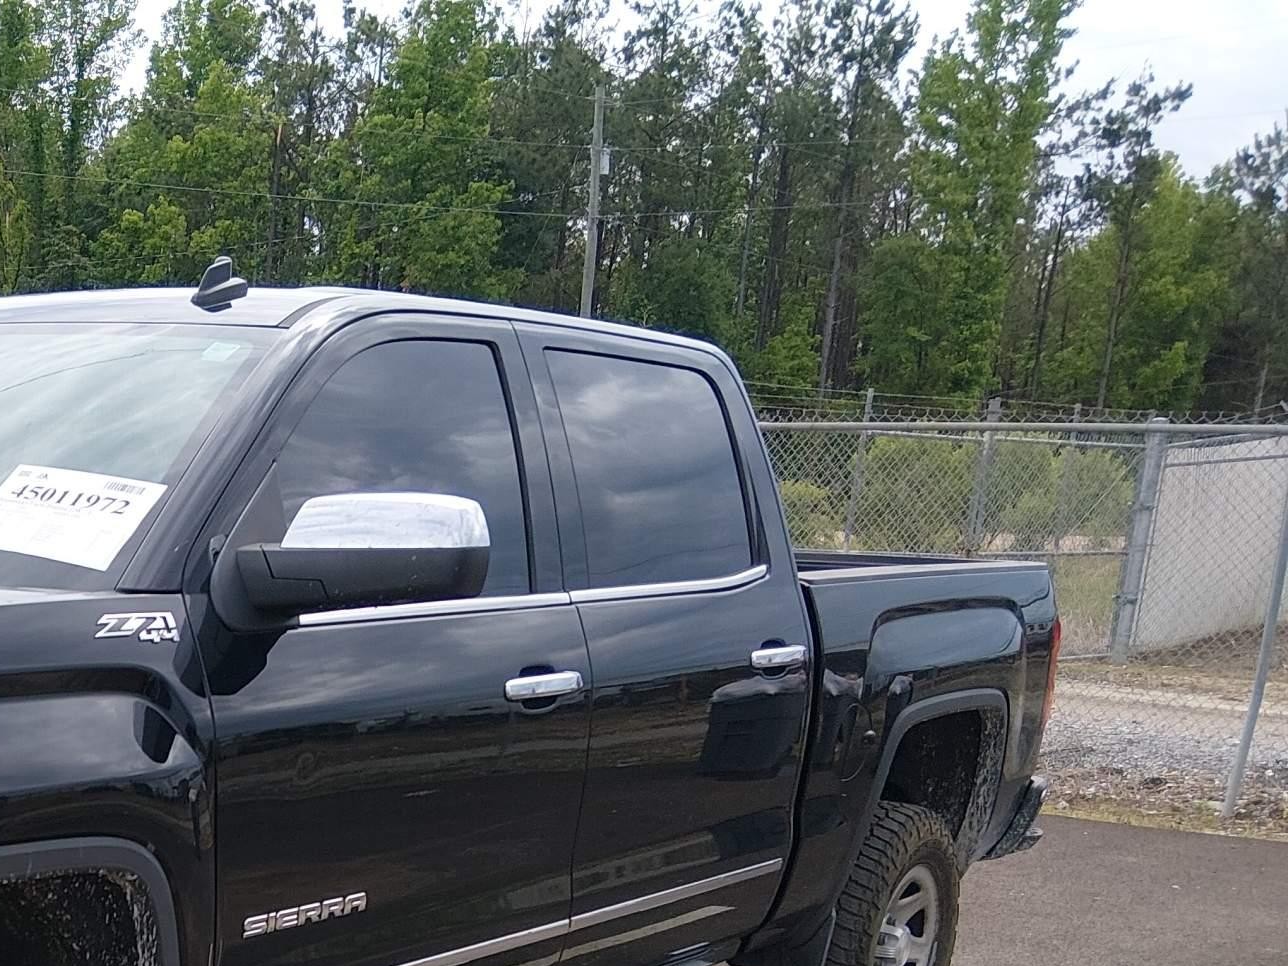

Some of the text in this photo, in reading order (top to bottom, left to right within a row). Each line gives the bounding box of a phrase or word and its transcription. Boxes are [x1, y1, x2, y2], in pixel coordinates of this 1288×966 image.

[11, 484, 131, 515] 45011972
[94, 611, 177, 638] Z71
[242, 891, 367, 939] SIERRA
